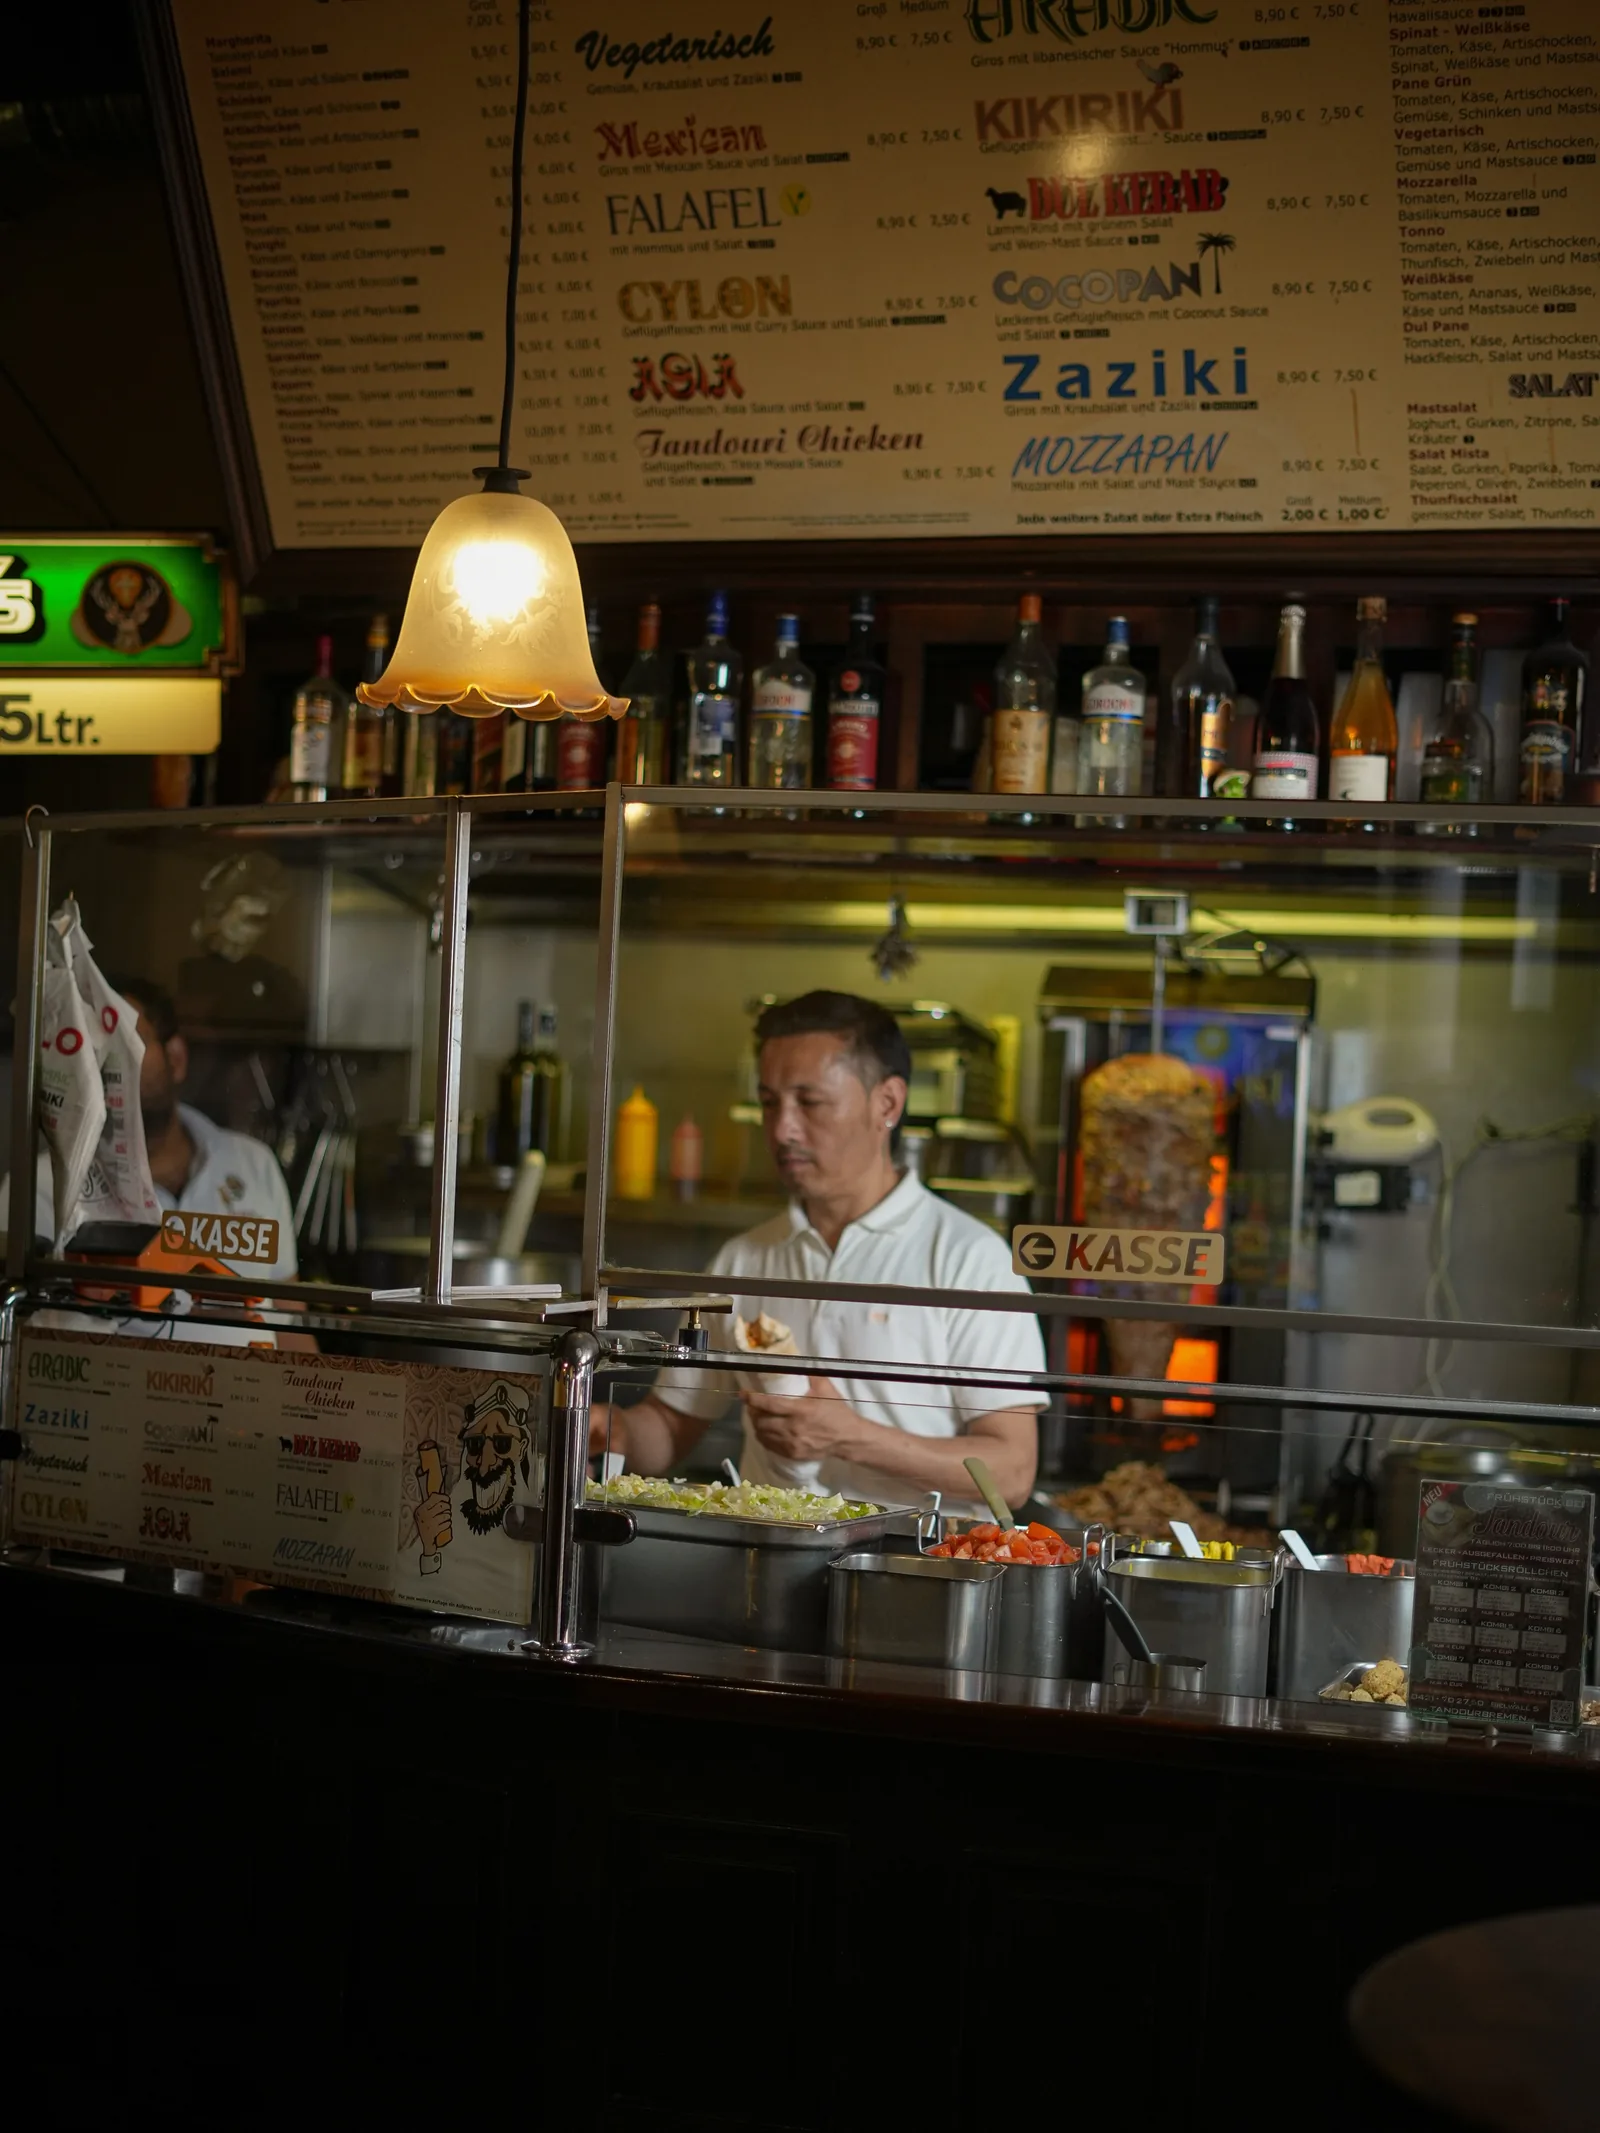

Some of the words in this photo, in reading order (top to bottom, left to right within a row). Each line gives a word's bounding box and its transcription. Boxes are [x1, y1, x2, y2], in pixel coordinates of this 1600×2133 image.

[1254, 8, 1286, 24] 8,90
[1313, 5, 1345, 20] 7,50
[856, 36, 886, 50] 8,90
[910, 32, 940, 48] 7,50
[1389, 26, 1439, 42] Spinat
[1455, 21, 1530, 37] Weißkäse
[574, 15, 776, 81] Vegetarisch
[971, 53, 1004, 68] Giros
[1008, 51, 1029, 65] mit
[1033, 47, 1116, 63] libanesischer
[1120, 44, 1160, 58] Sauce
[1390, 44, 1453, 58] Tomaten,
[1459, 40, 1497, 53] Käse,
[1502, 34, 1596, 50] Artischocken,
[1391, 60, 1439, 75] Spinat,
[1445, 57, 1510, 71] Weißkäse
[1515, 53, 1541, 66] und
[1392, 77, 1430, 90] Pane
[1434, 75, 1471, 88] Grün
[1393, 94, 1456, 108] Tomaten,
[1461, 91, 1499, 104] Käse,
[1504, 84, 1598, 101] Artischocken,
[974, 88, 1185, 141] KIKIRIKI
[1393, 110, 1453, 124] Gemüse,
[1459, 105, 1521, 120] Schinken
[1526, 103, 1552, 116] und
[593, 112, 768, 161] Mexican
[1163, 131, 1203, 144] Sauce
[1394, 125, 1484, 142] Vegetarisch
[1394, 143, 1458, 156] Tomaten,
[1463, 140, 1500, 153] Käse,
[1506, 135, 1600, 151] Artischocken,
[1396, 159, 1451, 173] Gemüse
[1456, 157, 1481, 169] und
[1486, 155, 1558, 169] Mastsauce
[1397, 174, 1477, 189] Mozzarella
[1102, 168, 1229, 217] KEBAB
[1397, 191, 1460, 206] Tomaten,
[1465, 187, 1537, 202] Mozzarella
[1541, 186, 1568, 199] und
[604, 187, 782, 236] FALAFEL
[1398, 206, 1501, 222] Basilikumsauce
[986, 221, 1059, 238] Lamm/Rind
[1062, 219, 1084, 232] mit
[1087, 218, 1137, 234] grünem
[1141, 216, 1174, 229] Salat
[1398, 225, 1446, 238] Tonno
[988, 239, 1013, 252] und
[1085, 234, 1125, 247] Sauce
[1399, 240, 1462, 254] Tomaten,
[1467, 237, 1504, 251] Käse,
[1509, 235, 1600, 250] Artischocken,
[1400, 255, 1469, 270] Thunfisch,
[1474, 252, 1535, 267] Zwiebeln
[1540, 251, 1565, 264] und
[992, 260, 1203, 311] COCOPAN
[1401, 272, 1474, 286] Weißkäse
[617, 274, 793, 323] CYLON
[1402, 288, 1464, 302] Tomaten,
[1468, 287, 1523, 300] Ananas,
[1528, 284, 1597, 298] Weißkäse,
[1148, 307, 1170, 320] mit
[1229, 305, 1269, 318] Sauce
[1402, 304, 1435, 317] Käse
[1439, 303, 1464, 316] und
[1468, 301, 1540, 315] Mastsauce
[1403, 321, 1428, 333] Dul
[1432, 320, 1470, 332] Pane
[1404, 336, 1465, 349] Tomaten,
[1470, 334, 1507, 348] Käse,
[1512, 332, 1600, 346] Artischocken,
[1404, 350, 1483, 365] Hackfleisch,
[1488, 349, 1523, 362] Salat
[1527, 349, 1553, 362] und
[1002, 346, 1248, 401] Zaziki
[1508, 371, 1600, 399] SALAT
[1004, 404, 1037, 417] Giros
[1040, 403, 1061, 415] mit
[1064, 401, 1128, 416] Krautsalat
[1131, 401, 1156, 413] und
[1406, 401, 1478, 415] Mastsalat
[1407, 416, 1461, 431] Joghurt,
[1466, 416, 1520, 430] Gurken,
[1524, 414, 1577, 428] Zitrone,
[634, 427, 787, 459] Tandouri
[796, 423, 925, 455] Chicken
[1408, 432, 1457, 445] Kräuter
[1011, 431, 1230, 478] MOZZAPAN
[1409, 448, 1446, 460] Salat
[1450, 448, 1490, 460] Mista
[1410, 464, 1447, 477] Salat,
[1509, 461, 1563, 476] Paprika,
[1410, 478, 1472, 492] Peperoni,
[1527, 477, 1586, 490] Zwiebeln
[1411, 494, 1518, 506] Thunfischsalat
[1530, 507, 1595, 520] Thunfisch
[189, 1218, 273, 1259] KASSE
[1064, 1233, 1212, 1277] KASSE
[27, 1352, 92, 1383] ARABIC
[146, 1369, 214, 1398] KIKIRIKI
[281, 1369, 344, 1392] Tandouri
[304, 1389, 356, 1411] Chicken
[24, 1403, 89, 1431] Zaziki
[144, 1420, 208, 1444] COCOPAN
[141, 1462, 213, 1494] Mexican
[275, 1483, 343, 1515] FALAFEL
[1422, 1485, 1443, 1507] NEU
[1487, 1491, 1562, 1508] FRÜHSTÜCK
[20, 1491, 89, 1525] CYLON
[272, 1536, 356, 1568] MOZZAPAN
[1422, 1546, 1457, 1556] LECKER
[1461, 1550, 1525, 1561] AUSGEFALLEN
[1529, 1555, 1581, 1566] PREISWERT
[1563, 1546, 1581, 1554] UHR
